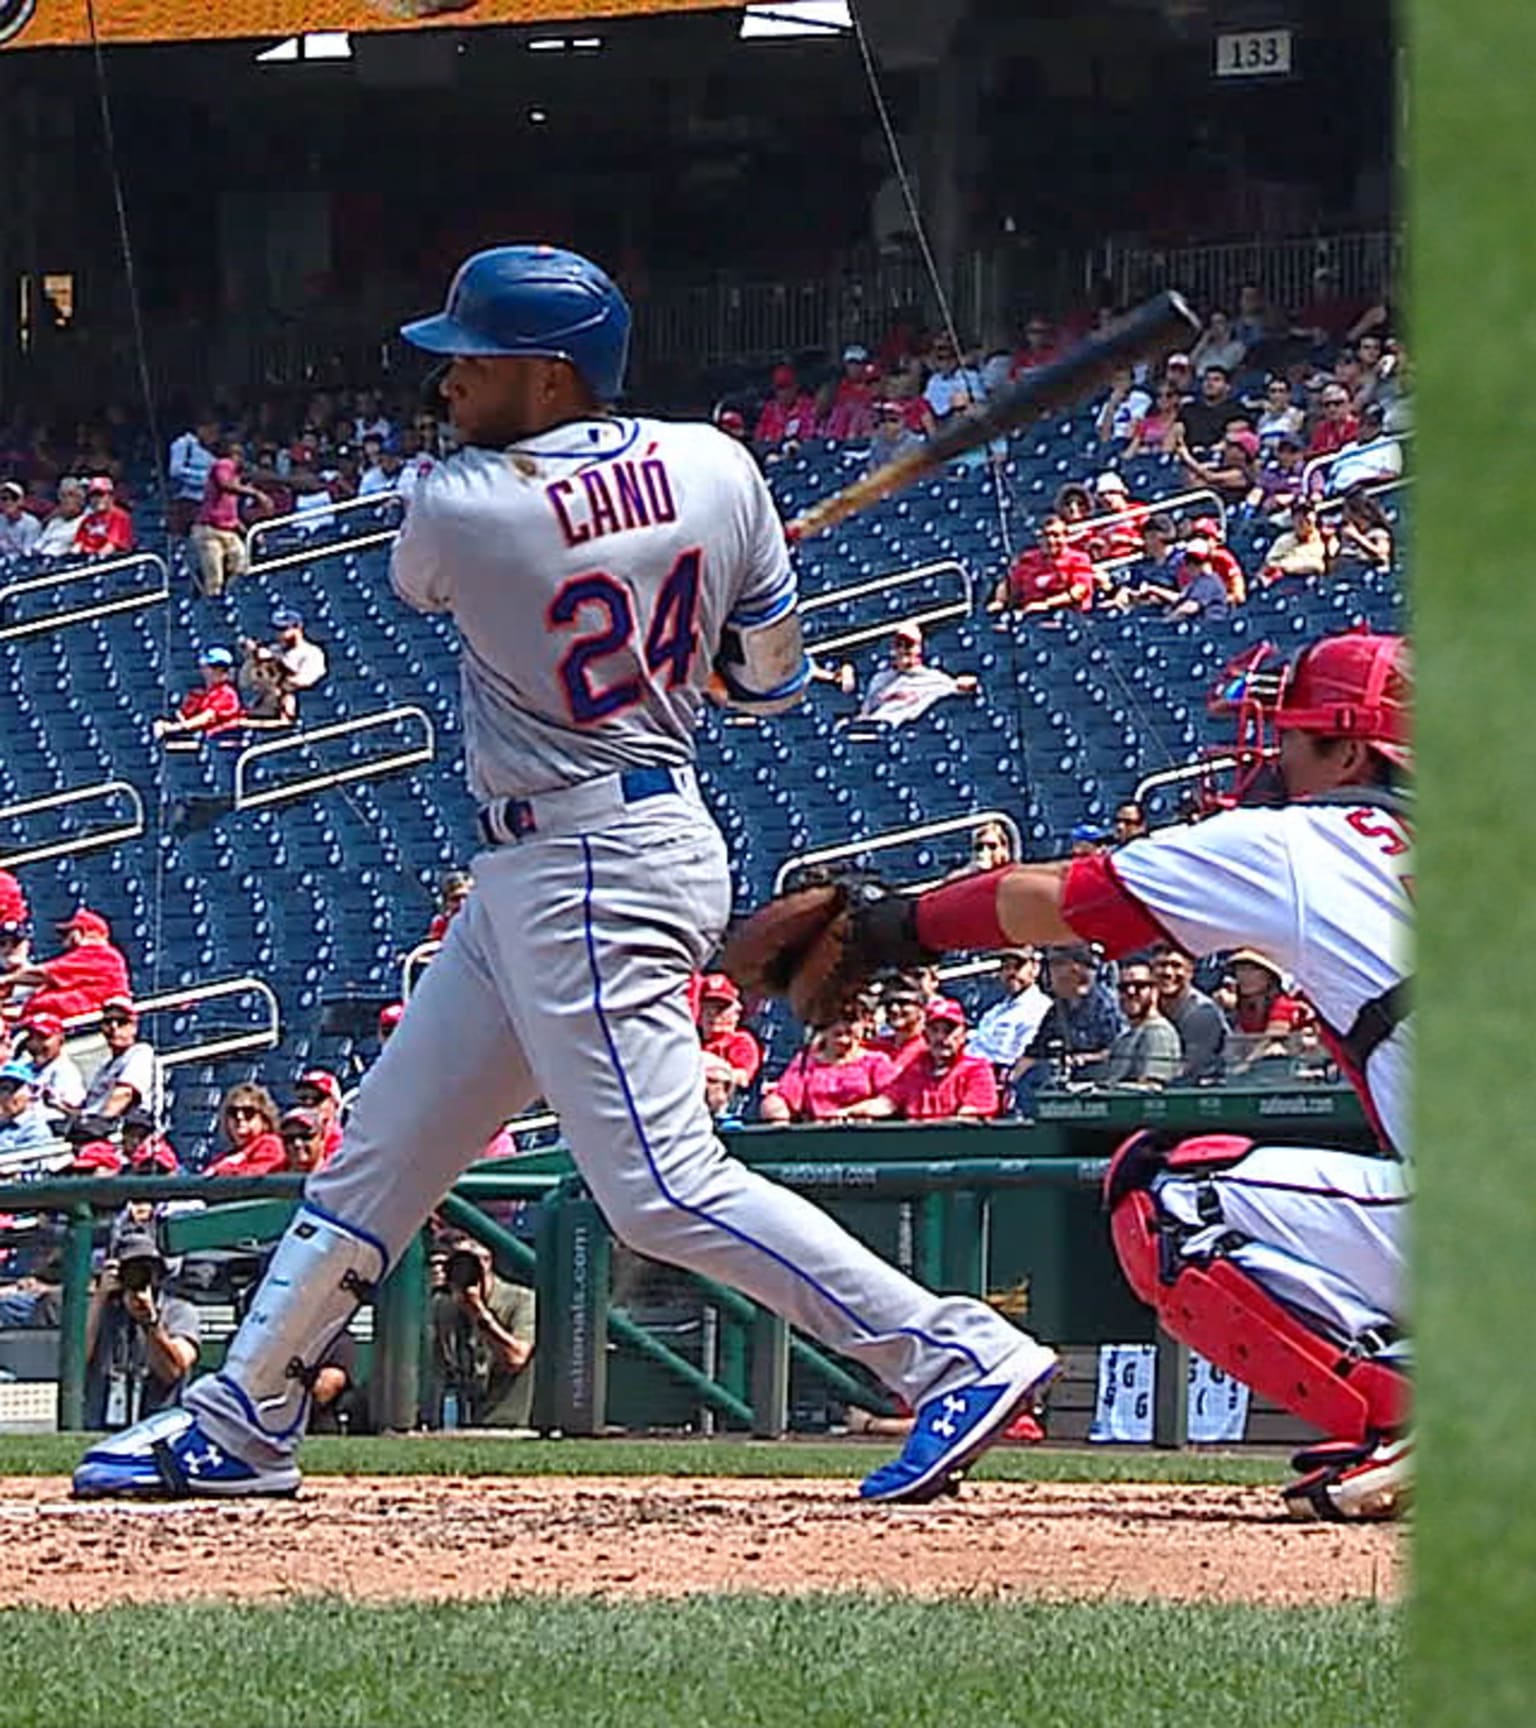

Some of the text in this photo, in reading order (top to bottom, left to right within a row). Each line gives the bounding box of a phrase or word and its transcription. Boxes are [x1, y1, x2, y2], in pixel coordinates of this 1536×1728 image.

[1231, 37, 1279, 69] 133
[545, 441, 678, 547] CANÓ
[544, 546, 702, 729] 24
[571, 1226, 588, 1408] nationals.com
